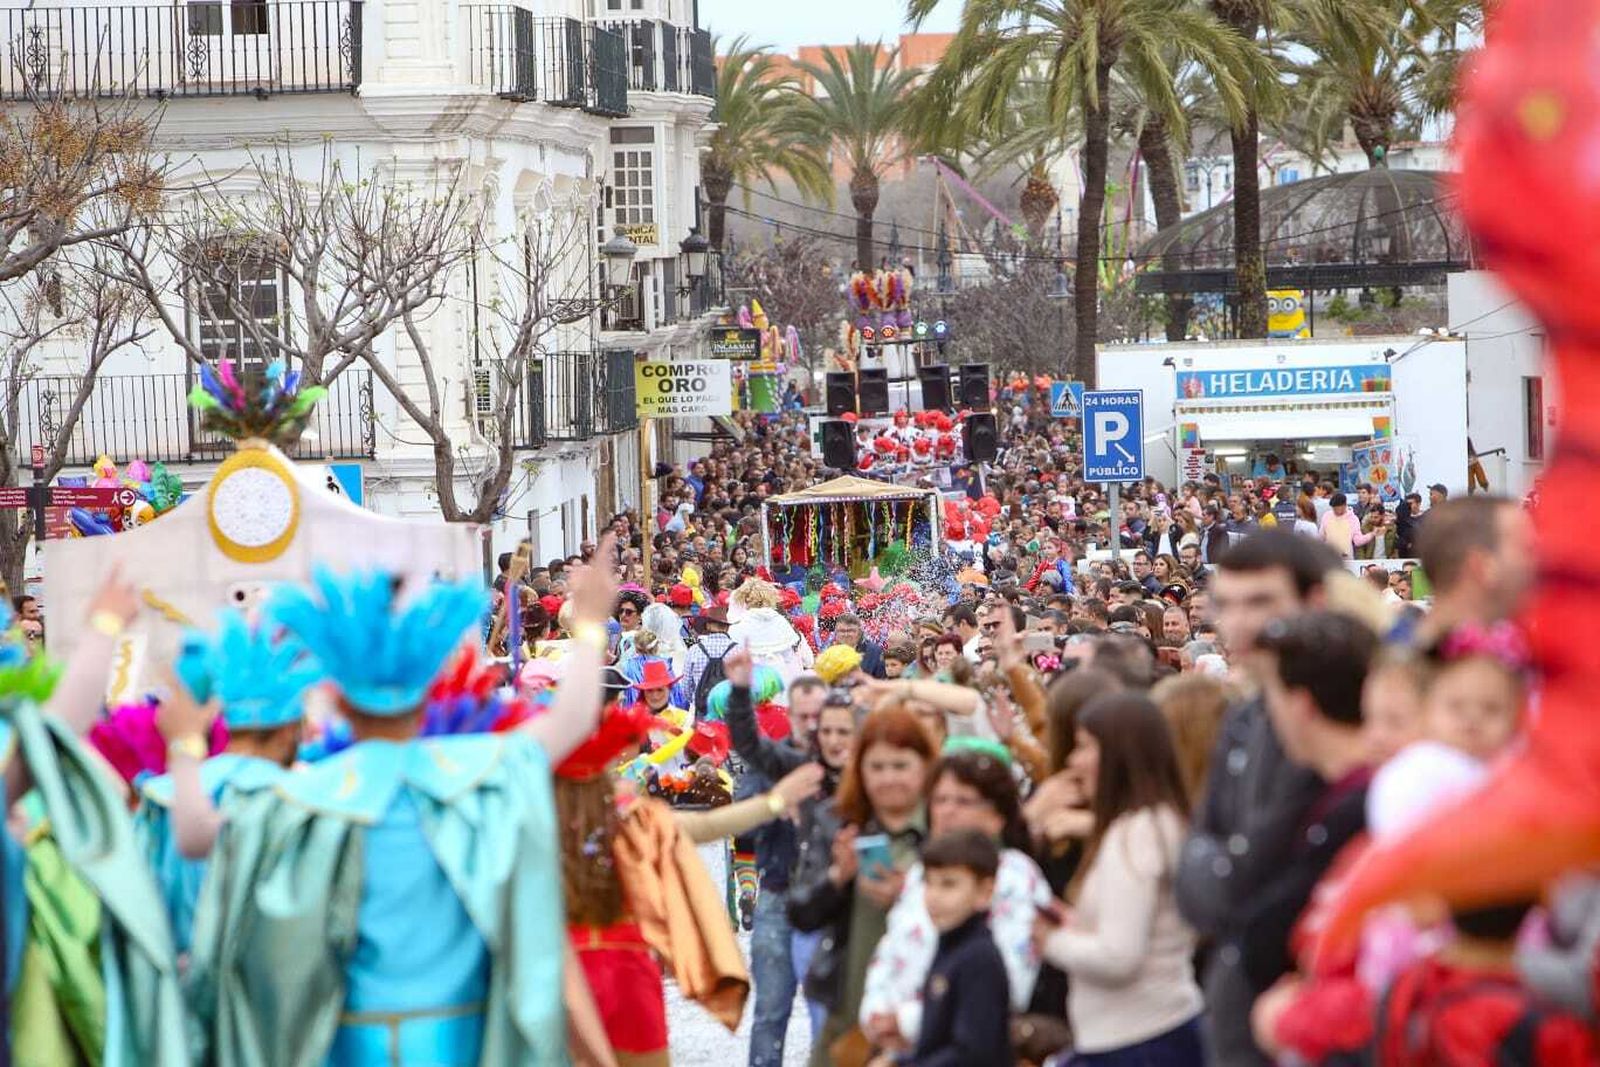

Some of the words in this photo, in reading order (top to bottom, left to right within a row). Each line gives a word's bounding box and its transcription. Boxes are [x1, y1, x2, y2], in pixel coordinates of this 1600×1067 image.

[629, 236, 655, 244] NTAL
[642, 364, 721, 377] COMPRO
[657, 377, 707, 393] ORO
[1210, 368, 1354, 394] HELADERIA
[657, 395, 678, 404] QUE
[681, 395, 693, 403] LO
[1085, 397, 1098, 406] 24
[1101, 396, 1139, 405] HORAS
[1094, 411, 1129, 455] P
